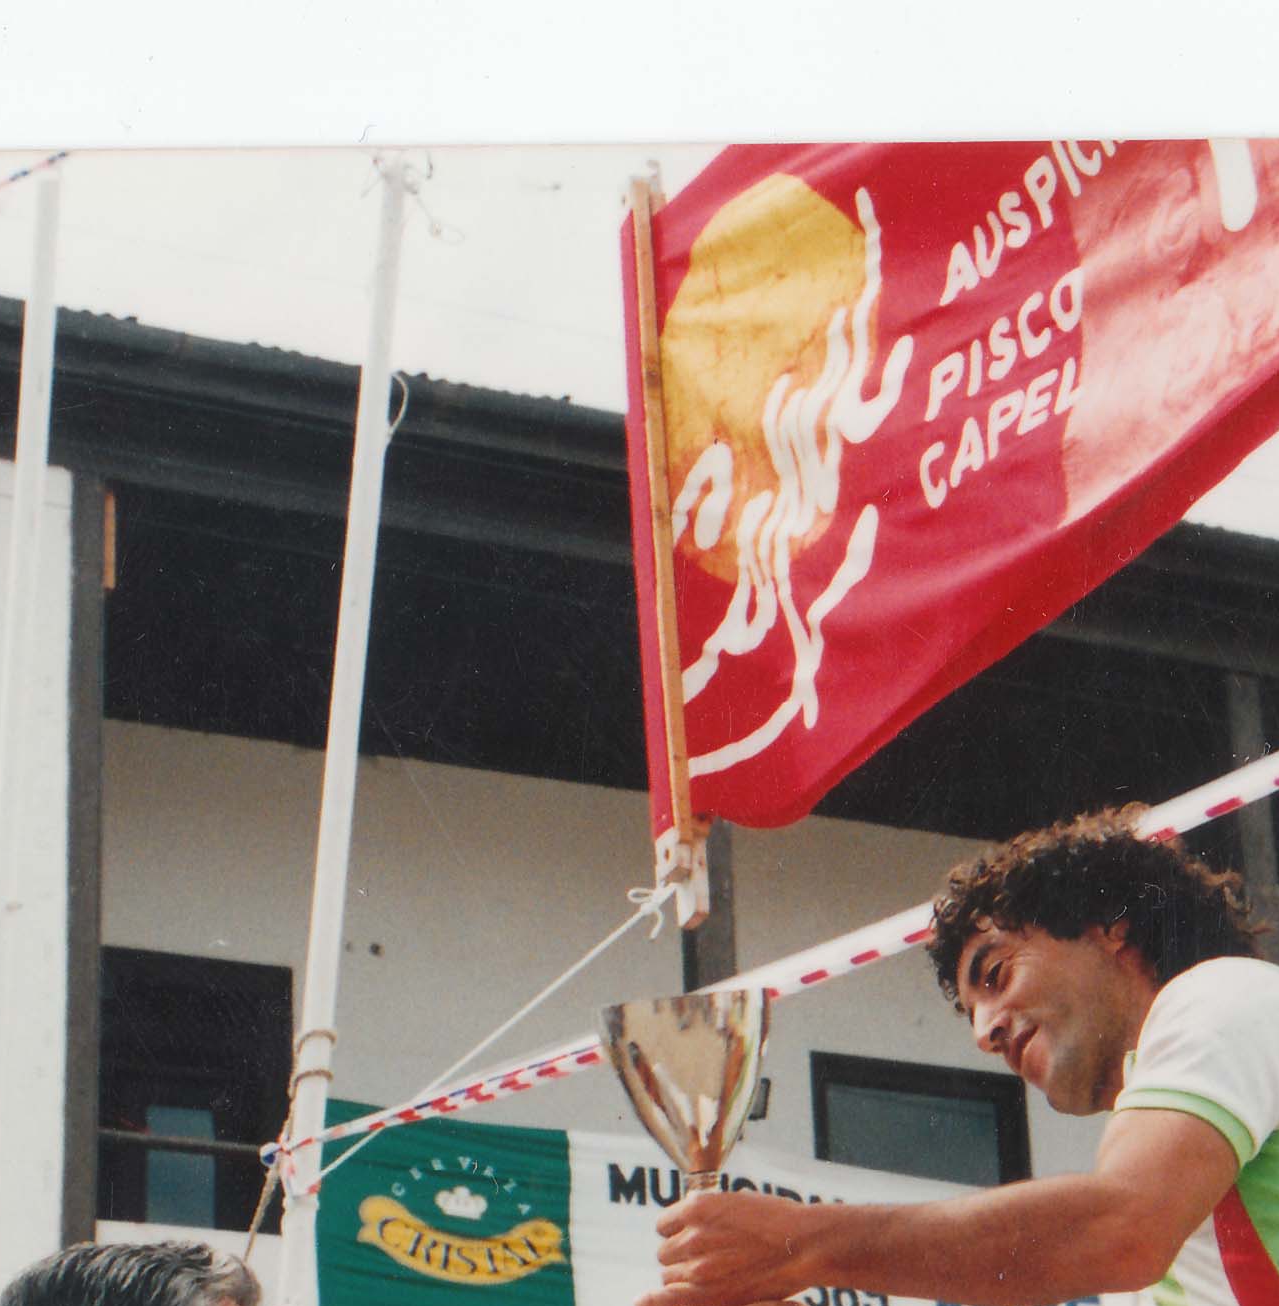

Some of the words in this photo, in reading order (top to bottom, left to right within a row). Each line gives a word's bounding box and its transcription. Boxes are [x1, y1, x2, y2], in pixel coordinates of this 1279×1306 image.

[923, 265, 1084, 423] PISCO
[919, 356, 1086, 509] CAPEL
[390, 1155, 532, 1216] CERVEZA
[376, 1216, 547, 1275] CRISTAL
